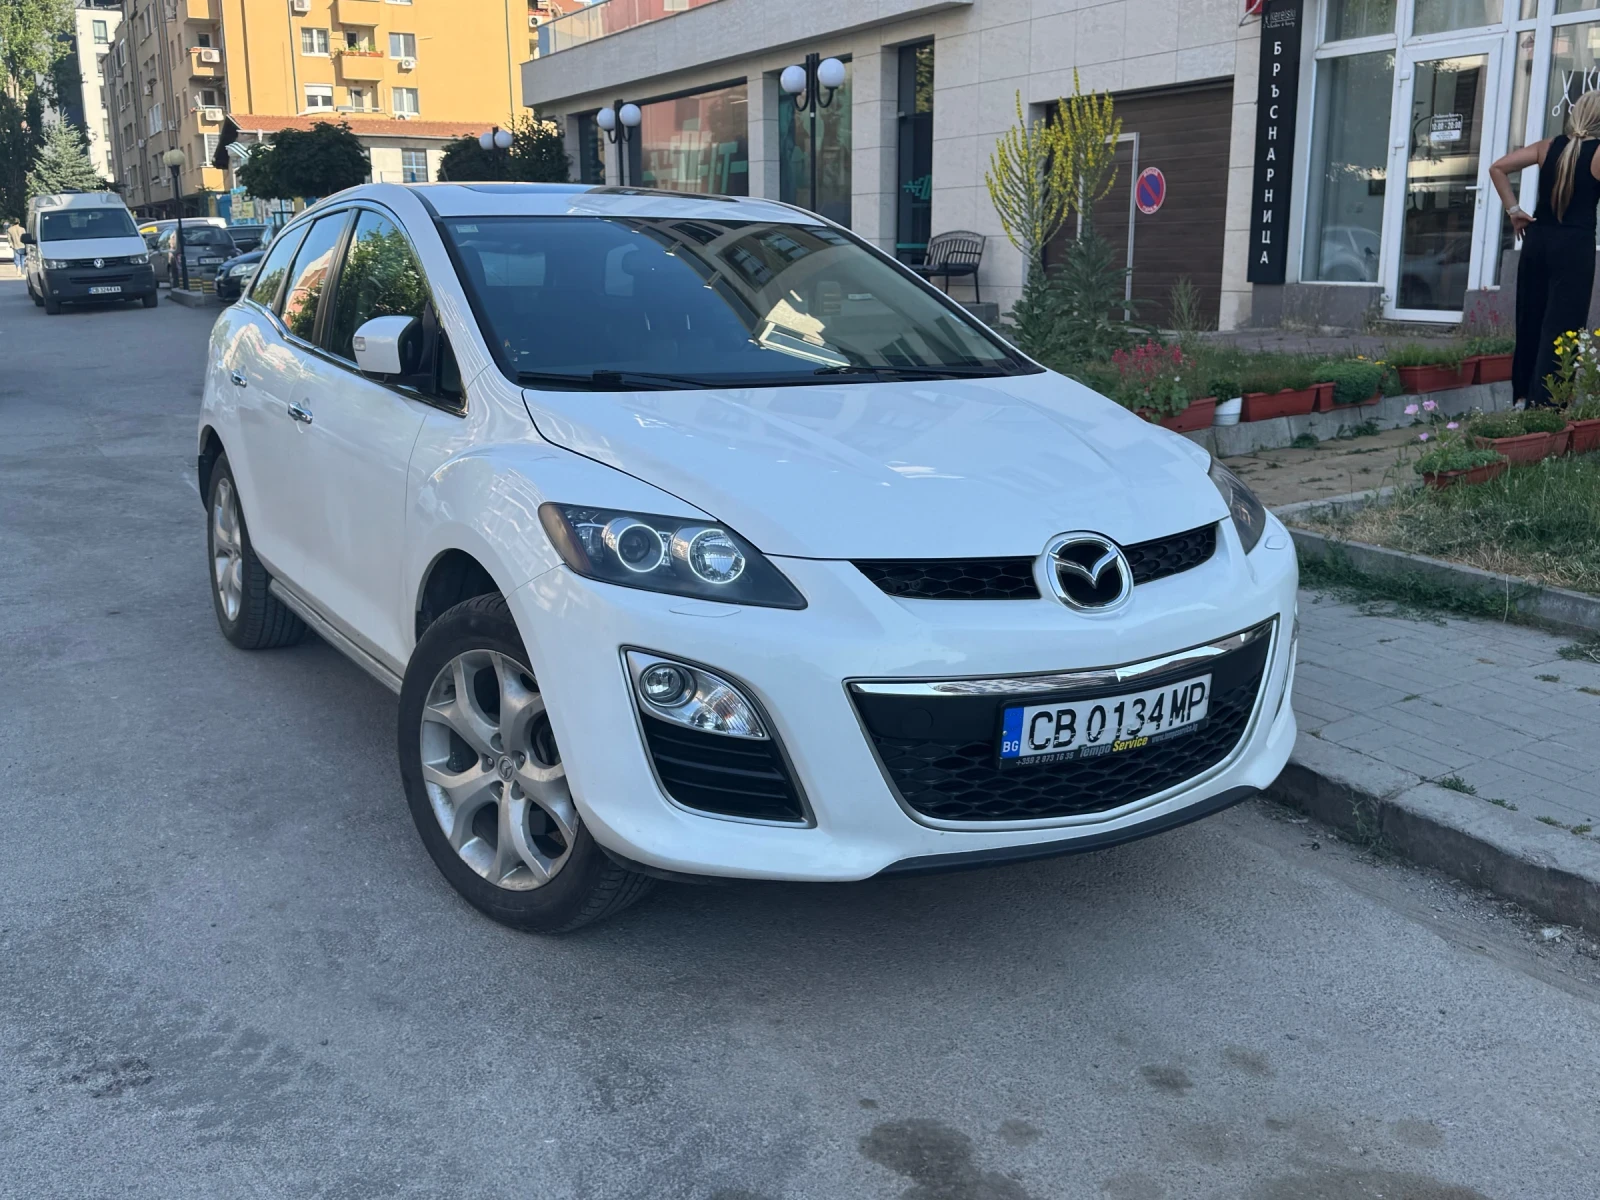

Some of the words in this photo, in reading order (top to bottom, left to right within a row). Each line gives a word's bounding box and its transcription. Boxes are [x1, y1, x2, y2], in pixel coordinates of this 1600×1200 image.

[1260, 42, 1281, 264] БРЪСНАРНИЦА
[1029, 708, 1077, 751] CB
[1087, 693, 1165, 743] 0134
[1169, 682, 1206, 727] MP
[1002, 740, 1019, 753] BG
[1079, 744, 1112, 758] Tempo
[1112, 735, 1149, 752] Service
[1015, 756, 1034, 766] +359
[1035, 756, 1041, 764] 2
[1056, 752, 1065, 760] 16
